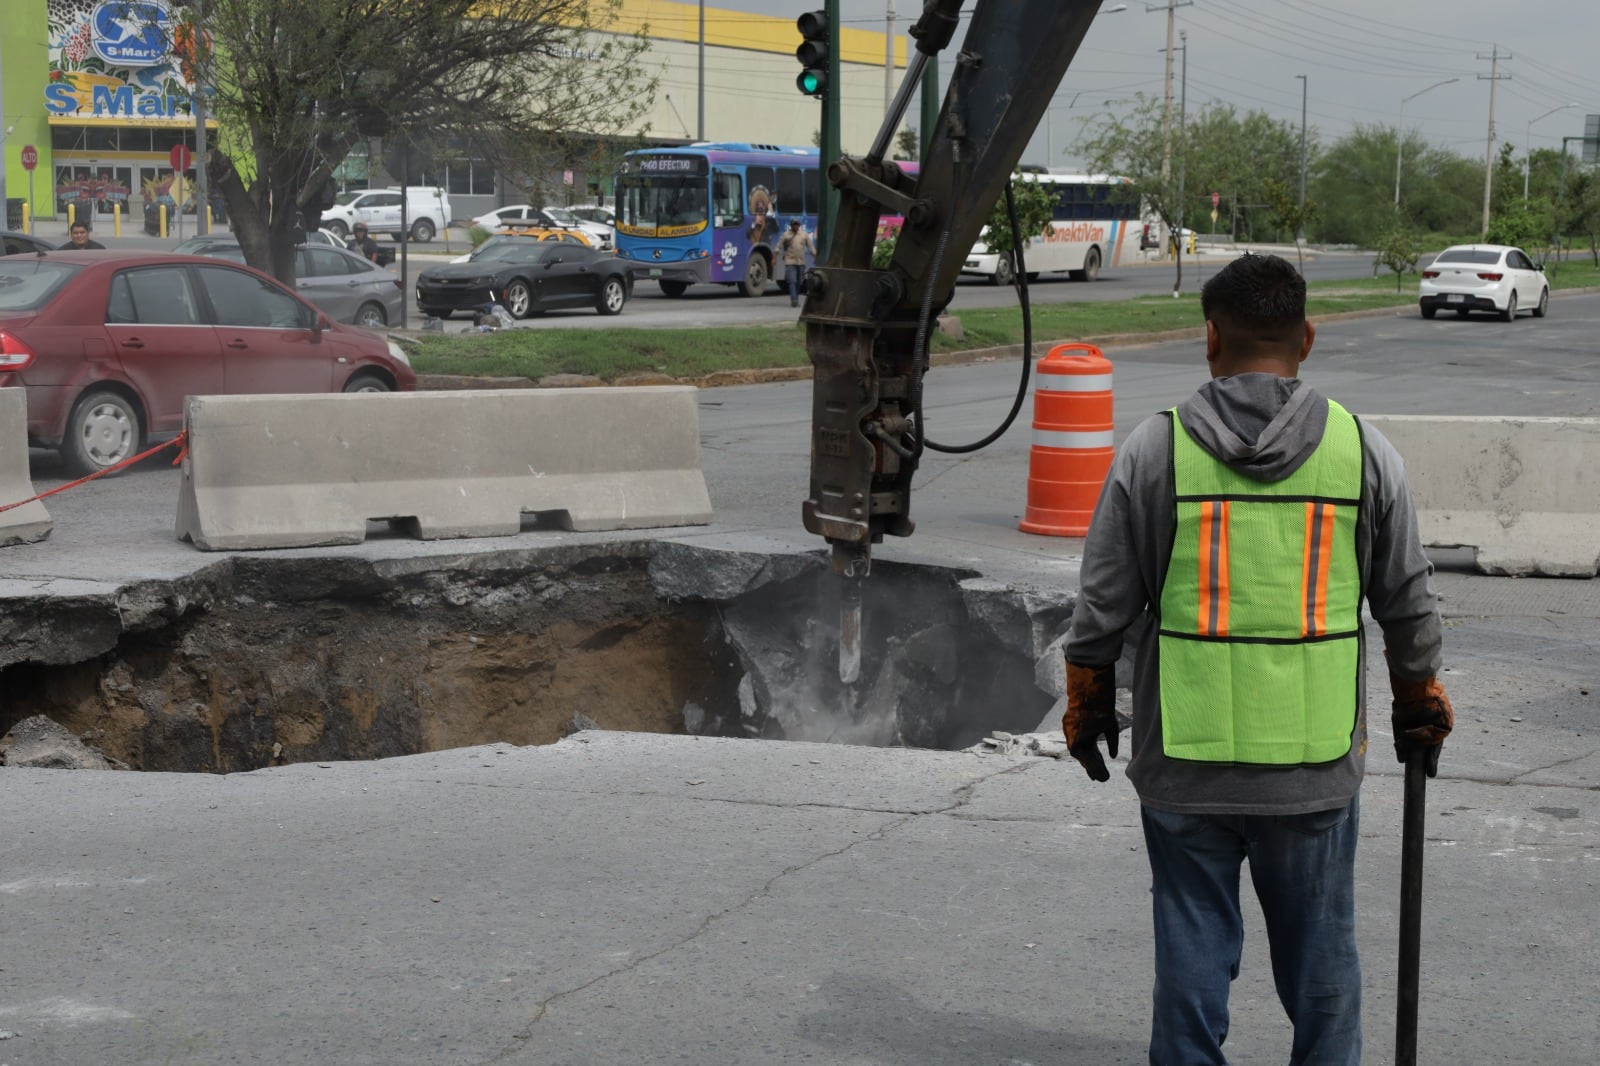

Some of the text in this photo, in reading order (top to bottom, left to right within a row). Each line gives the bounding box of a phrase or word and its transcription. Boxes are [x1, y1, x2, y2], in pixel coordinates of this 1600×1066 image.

[22, 151, 37, 164] ALTO
[658, 159, 691, 170] EFECTIVO
[659, 225, 700, 236] ALAMEDA
